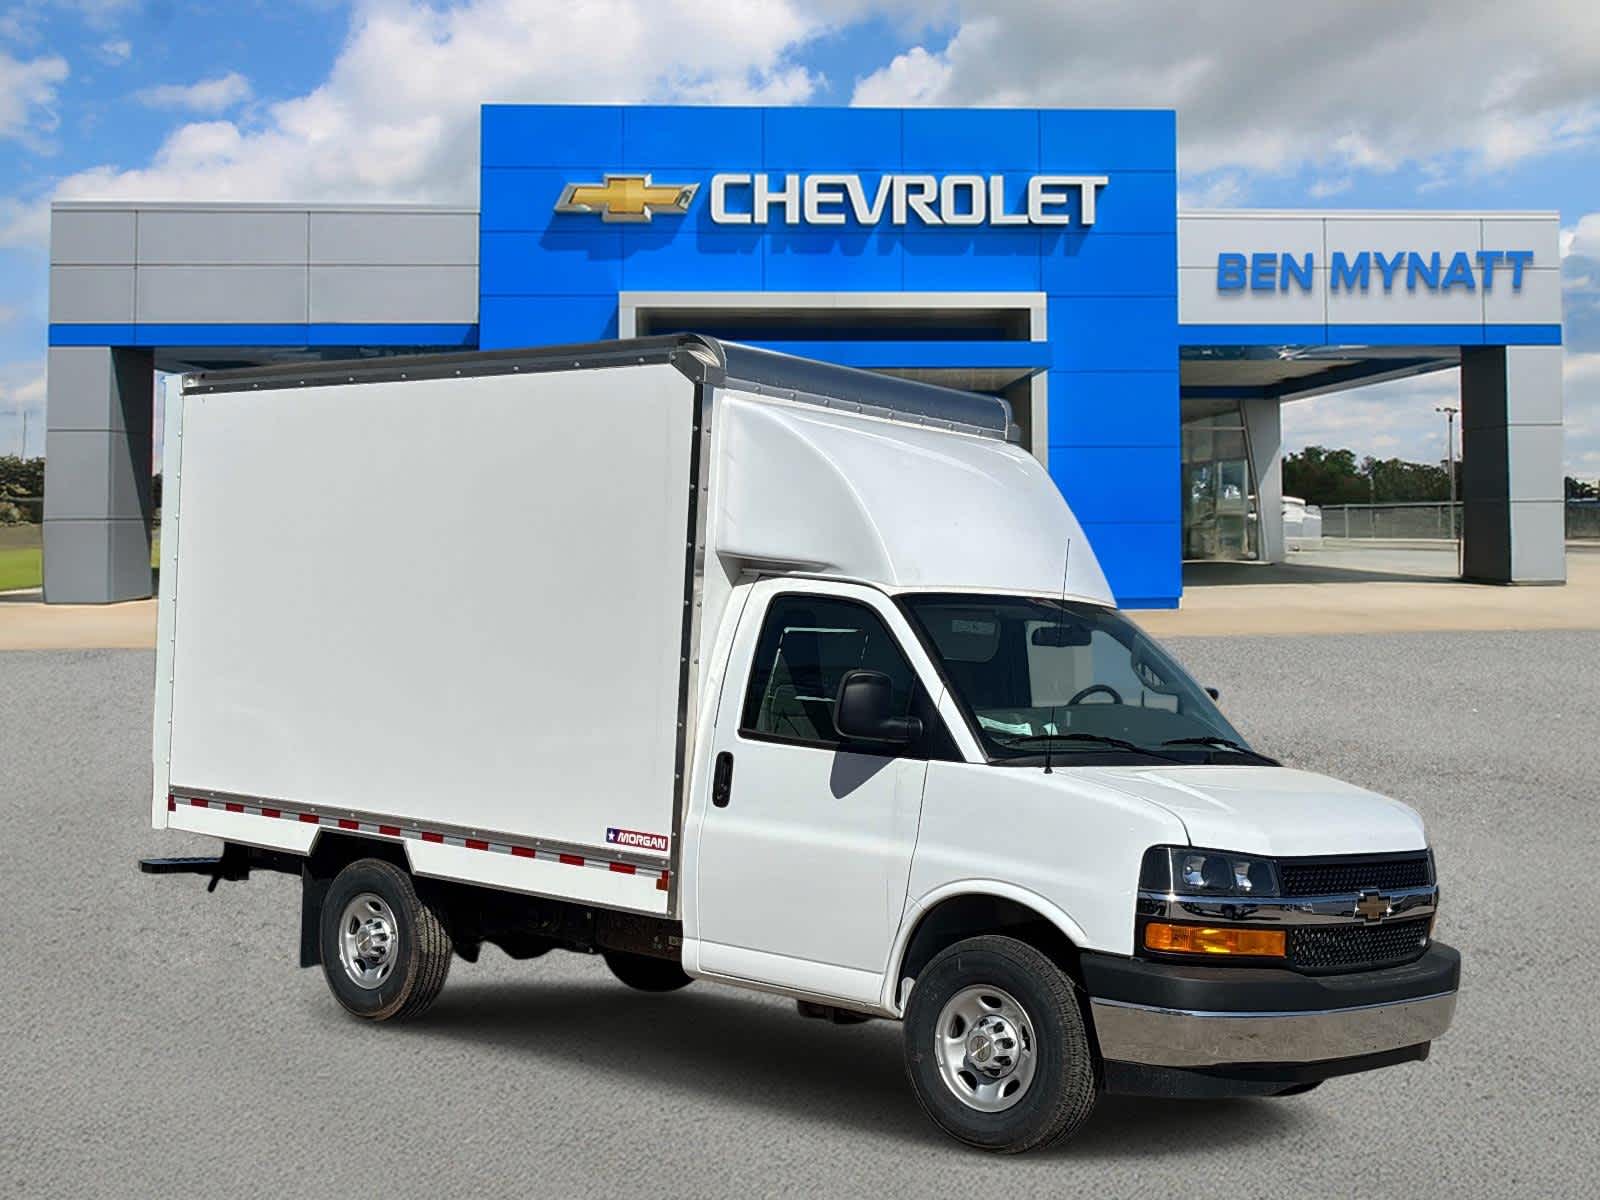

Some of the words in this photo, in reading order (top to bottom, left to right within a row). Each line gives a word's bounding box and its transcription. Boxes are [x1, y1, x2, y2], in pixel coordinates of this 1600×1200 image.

[710, 174, 1109, 225] CHEVROLET
[1217, 252, 1314, 291] BEN
[1330, 251, 1534, 290] MYNATT
[617, 831, 666, 849] MORGAN
